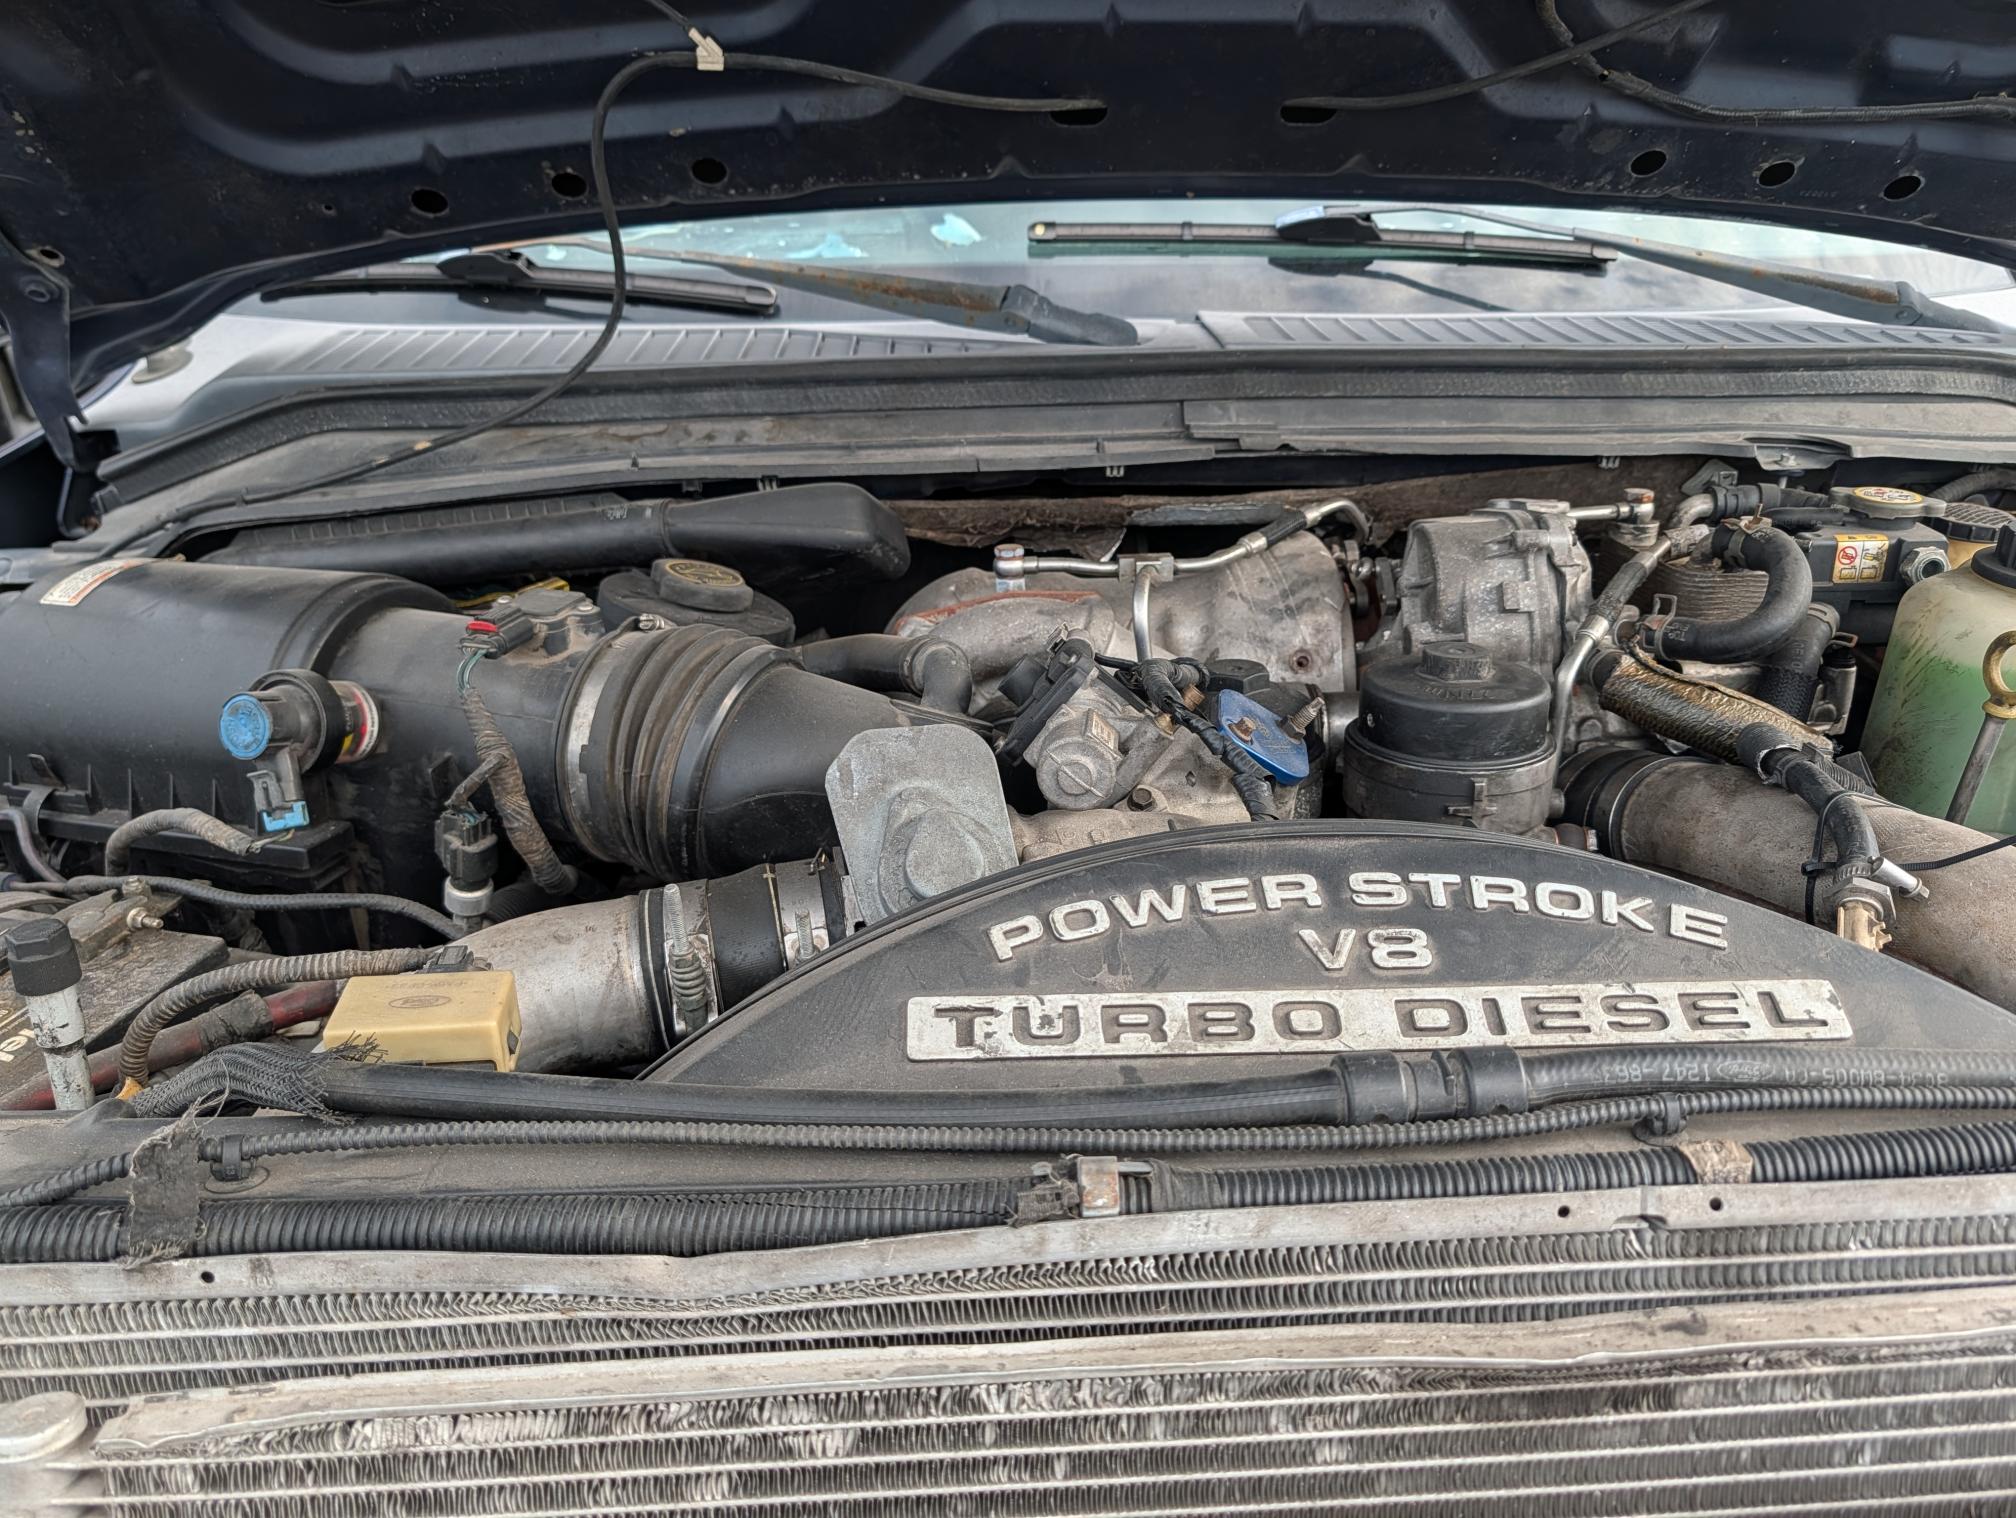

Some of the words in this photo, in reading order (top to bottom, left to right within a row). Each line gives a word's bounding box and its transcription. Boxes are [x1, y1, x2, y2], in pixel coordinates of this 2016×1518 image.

[988, 873, 1322, 961] POWER
[1348, 872, 1728, 949] STROKE
[1299, 928, 1433, 971] V8
[934, 1000, 1343, 1047] TURBO
[1394, 990, 1829, 1038] DIESEL
